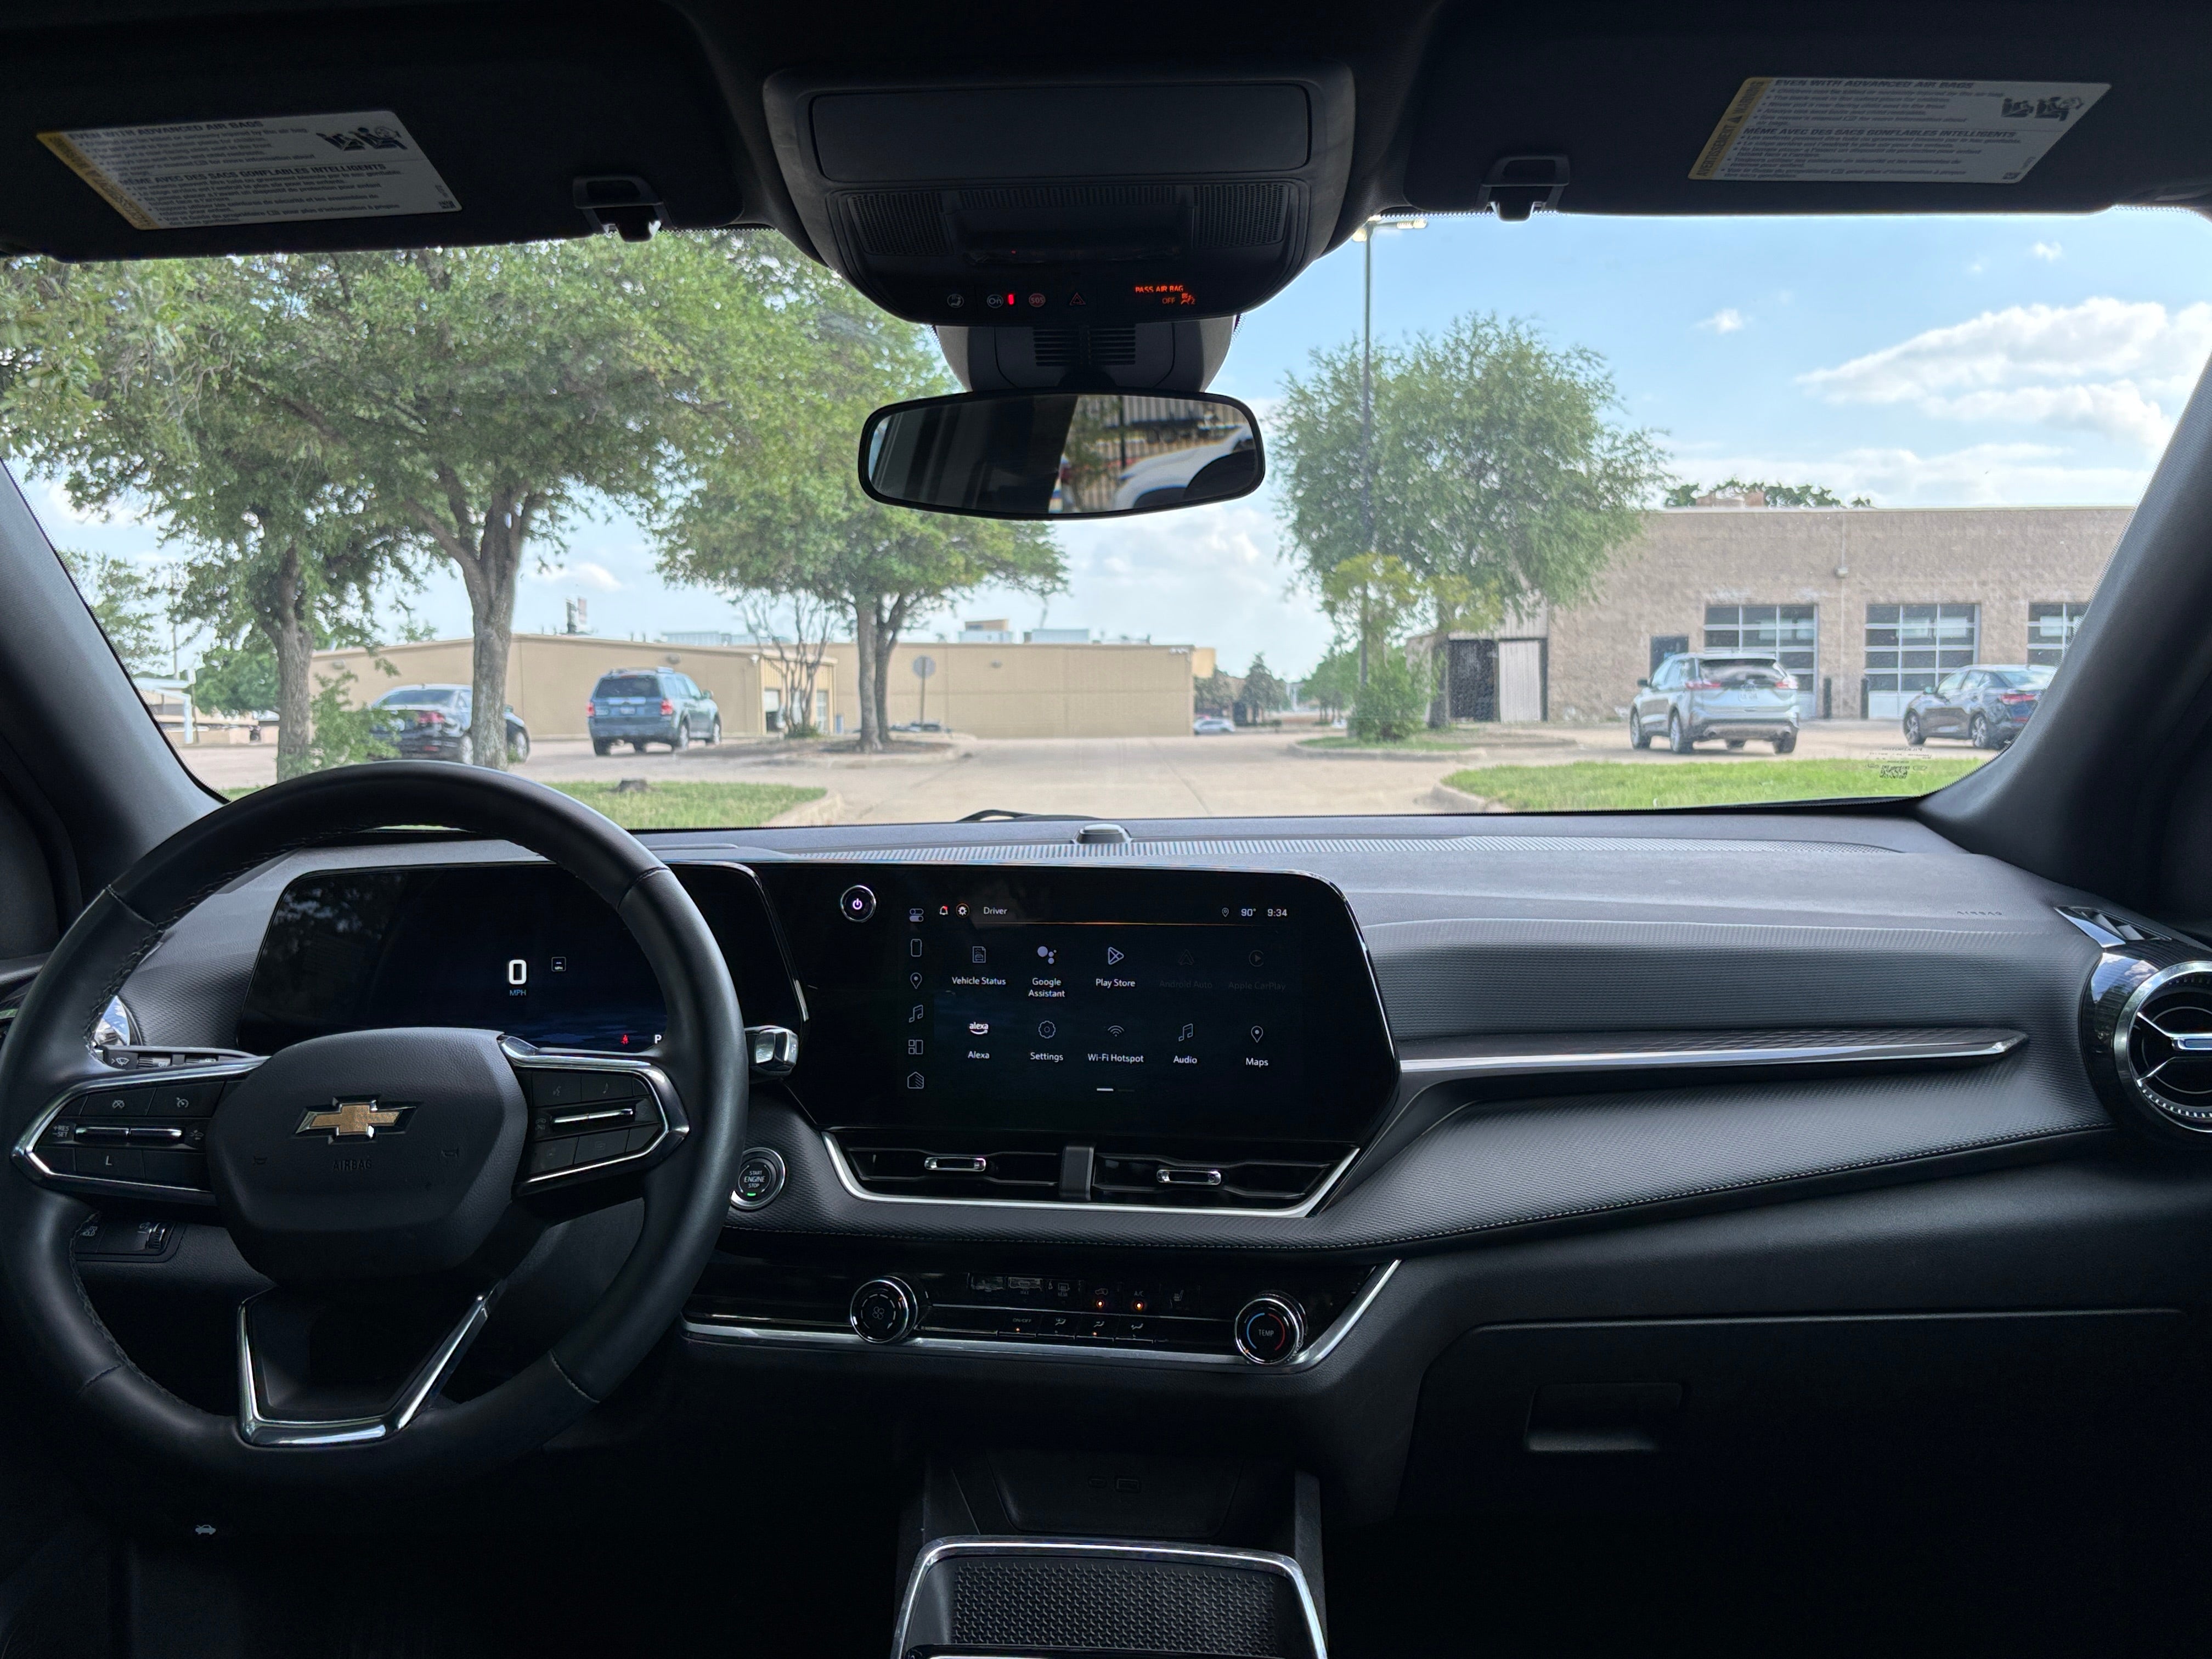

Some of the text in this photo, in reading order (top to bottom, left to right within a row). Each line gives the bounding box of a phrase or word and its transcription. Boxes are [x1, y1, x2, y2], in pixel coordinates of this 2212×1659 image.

[138, 125, 204, 136] ADVANCED
[206, 123, 228, 131] AIR
[229, 121, 263, 129] BAGS
[155, 175, 184, 184] AVEC
[184, 173, 208, 182] DES
[208, 171, 239, 179] SACS
[239, 167, 310, 177] GONFLABLES
[311, 163, 387, 174] INTELLIGENTS
[1135, 286, 1153, 294] PASS
[1030, 297, 1045, 306] SOS
[1162, 297, 1176, 305] OFF
[983, 906, 1007, 916] Driver
[1240, 908, 1288, 917] 90° 9:34
[508, 959, 527, 985] 0
[952, 977, 1006, 986] Vehicle Status
[1032, 978, 1062, 989] Google
[1095, 978, 1136, 989] Play Store
[1159, 980, 1212, 990] Android Auto
[1228, 982, 1286, 992] Apple CarPlay
[509, 989, 527, 997] MPH
[1028, 990, 1065, 998] Assistant
[654, 1035, 662, 1045] P
[968, 1051, 990, 1060] Alexa
[1030, 1052, 1063, 1063] Settings
[1087, 1053, 1144, 1065] Wi-Fi Hotspot
[1173, 1056, 1197, 1065] Audio
[1245, 1058, 1268, 1069] Maps
[333, 1159, 372, 1171] AIRBAG
[1258, 1329, 1274, 1337] TEMP
